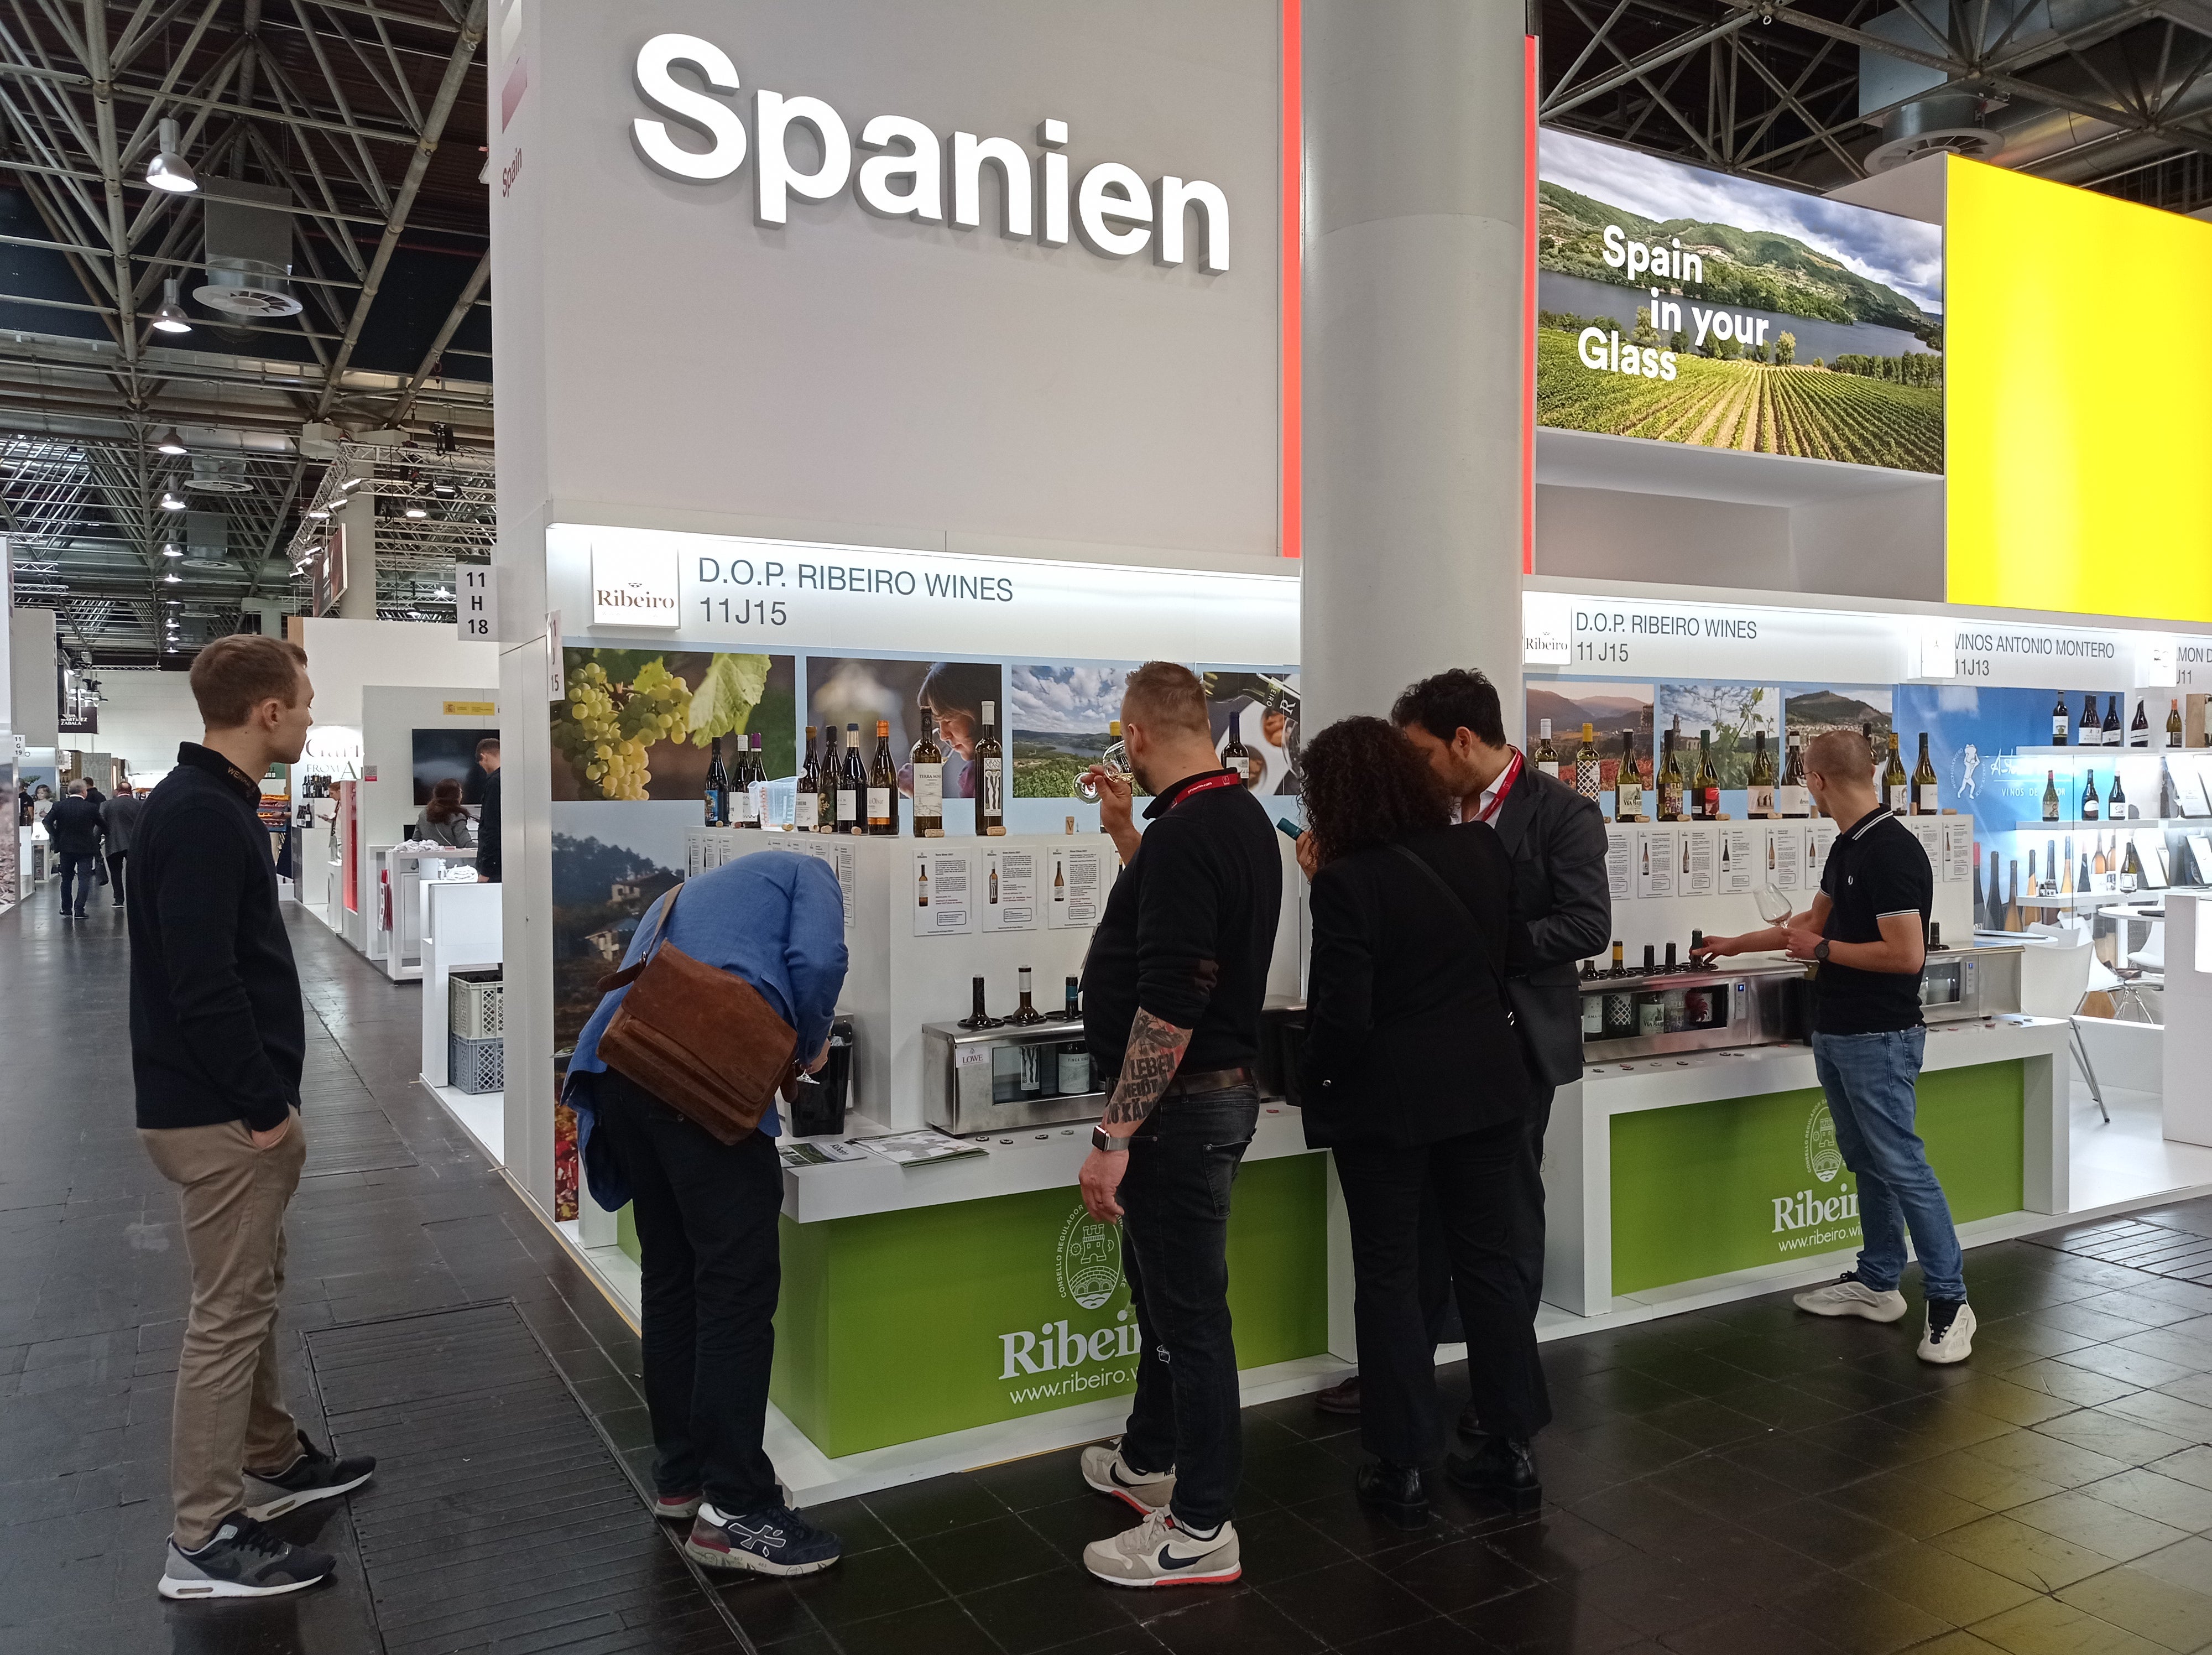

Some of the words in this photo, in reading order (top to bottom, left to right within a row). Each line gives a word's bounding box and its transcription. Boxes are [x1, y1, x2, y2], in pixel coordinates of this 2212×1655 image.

[629, 33, 1229, 275] Spanien
[1603, 225, 1703, 284] Spain
[1651, 287, 1681, 332] in
[1692, 306, 1769, 346] your
[1578, 327, 1677, 381] Glass
[467, 572, 485, 587] 11
[699, 558, 786, 587] D.O.P.
[799, 564, 916, 596] RIBEIRO
[925, 573, 1013, 602] WINES
[472, 595, 482, 610] H
[597, 590, 675, 609] Ribeiro
[700, 597, 787, 626] 11J15
[468, 619, 488, 634] 18
[1577, 612, 1625, 632] D.O.P.
[1632, 615, 1699, 636] RIBEIRO
[1705, 618, 1757, 639] WINES
[1526, 637, 1568, 651] Ribeiro
[1955, 633, 1992, 651] VINOS
[1996, 636, 2052, 655] ANTONIO
[2056, 639, 2114, 659] MONTERO
[1956, 658, 1989, 676] 11J13
[2002, 788, 2024, 797] VINOS
[2030, 787, 2038, 796] DE
[963, 1054, 984, 1064] LOWE
[1771, 1183, 1859, 1234] Ribeir
[1057, 1204, 1084, 1252] REGULADOR
[1778, 1221, 1863, 1252] www.ribeiro.wi
[1056, 1256, 1067, 1298] CONSELLO
